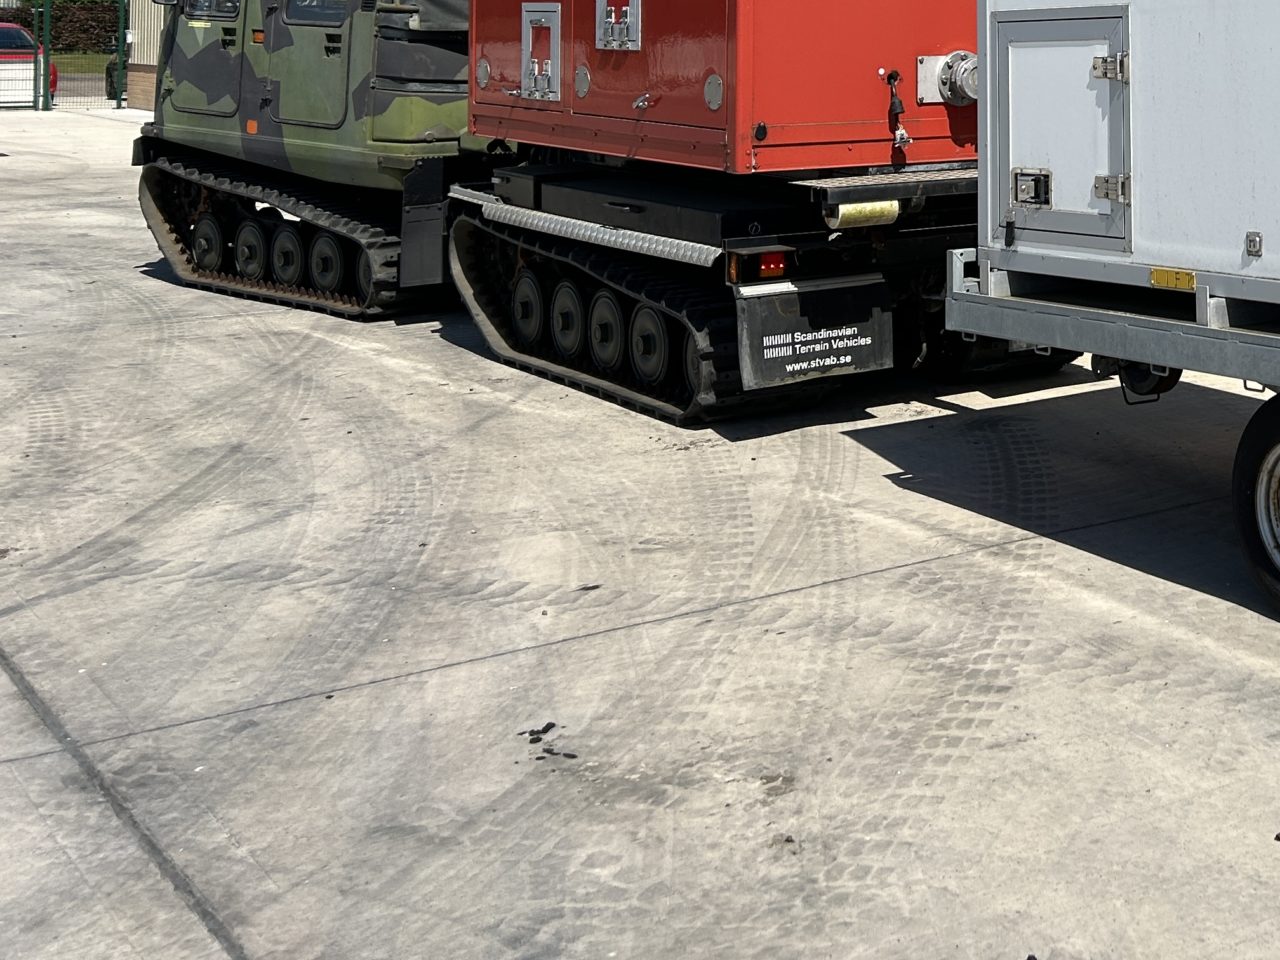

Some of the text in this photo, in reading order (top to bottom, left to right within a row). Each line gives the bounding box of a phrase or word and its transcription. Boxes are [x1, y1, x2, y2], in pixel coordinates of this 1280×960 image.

[794, 326, 858, 343] Scandinavian
[795, 335, 872, 355] Terrain Vehicles
[785, 354, 852, 372] www.stvab.se
